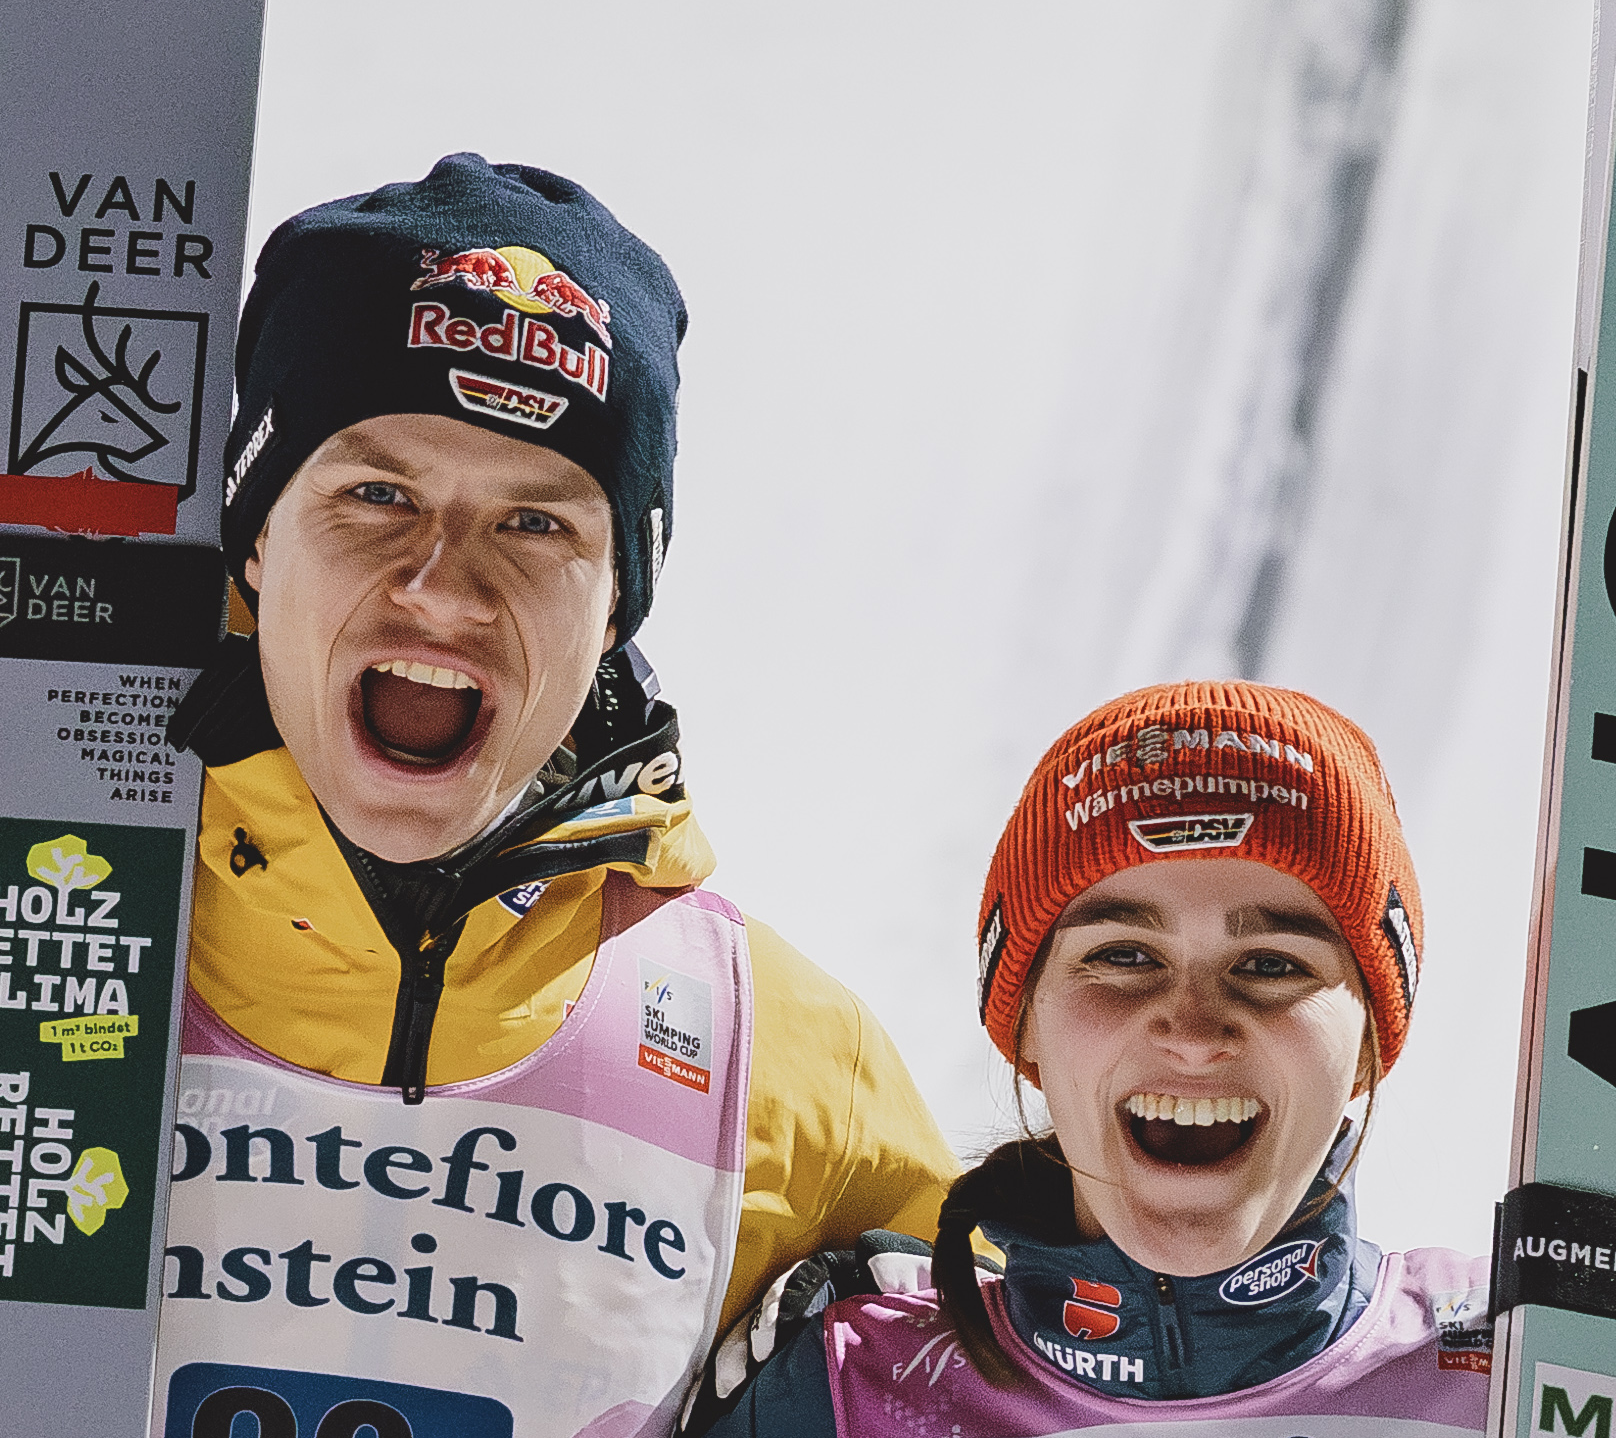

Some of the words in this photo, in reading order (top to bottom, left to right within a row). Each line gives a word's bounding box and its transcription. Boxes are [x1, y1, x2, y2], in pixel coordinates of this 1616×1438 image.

[48, 170, 197, 225] VAN
[22, 223, 215, 281] DEER
[29, 575, 96, 599] VAN
[27, 599, 114, 624] DEER
[119, 674, 182, 691] WHEN
[47, 689, 181, 710] PERFECTION
[79, 710, 169, 728] BECOME
[57, 727, 169, 747] OBSESSIO
[81, 748, 176, 766] MAGICAL
[97, 767, 175, 785] THINGS
[109, 787, 174, 804] ARISE
[1065, 775, 1309, 832] Wärmepumpen
[645, 1006, 665, 1024] SKI
[51, 1025, 58, 1037] 1
[84, 1021, 132, 1035] bindet
[644, 1018, 701, 1050] JUMPING
[644, 1029, 678, 1053] WORLD
[678, 1042, 699, 1060] CUP
[23, 1107, 76, 1245] HOLZ
[170, 1120, 689, 1282] ontefiore
[1230, 1243, 1308, 1293] personal
[164, 1232, 524, 1343] nstein
[1248, 1267, 1292, 1296] shop
